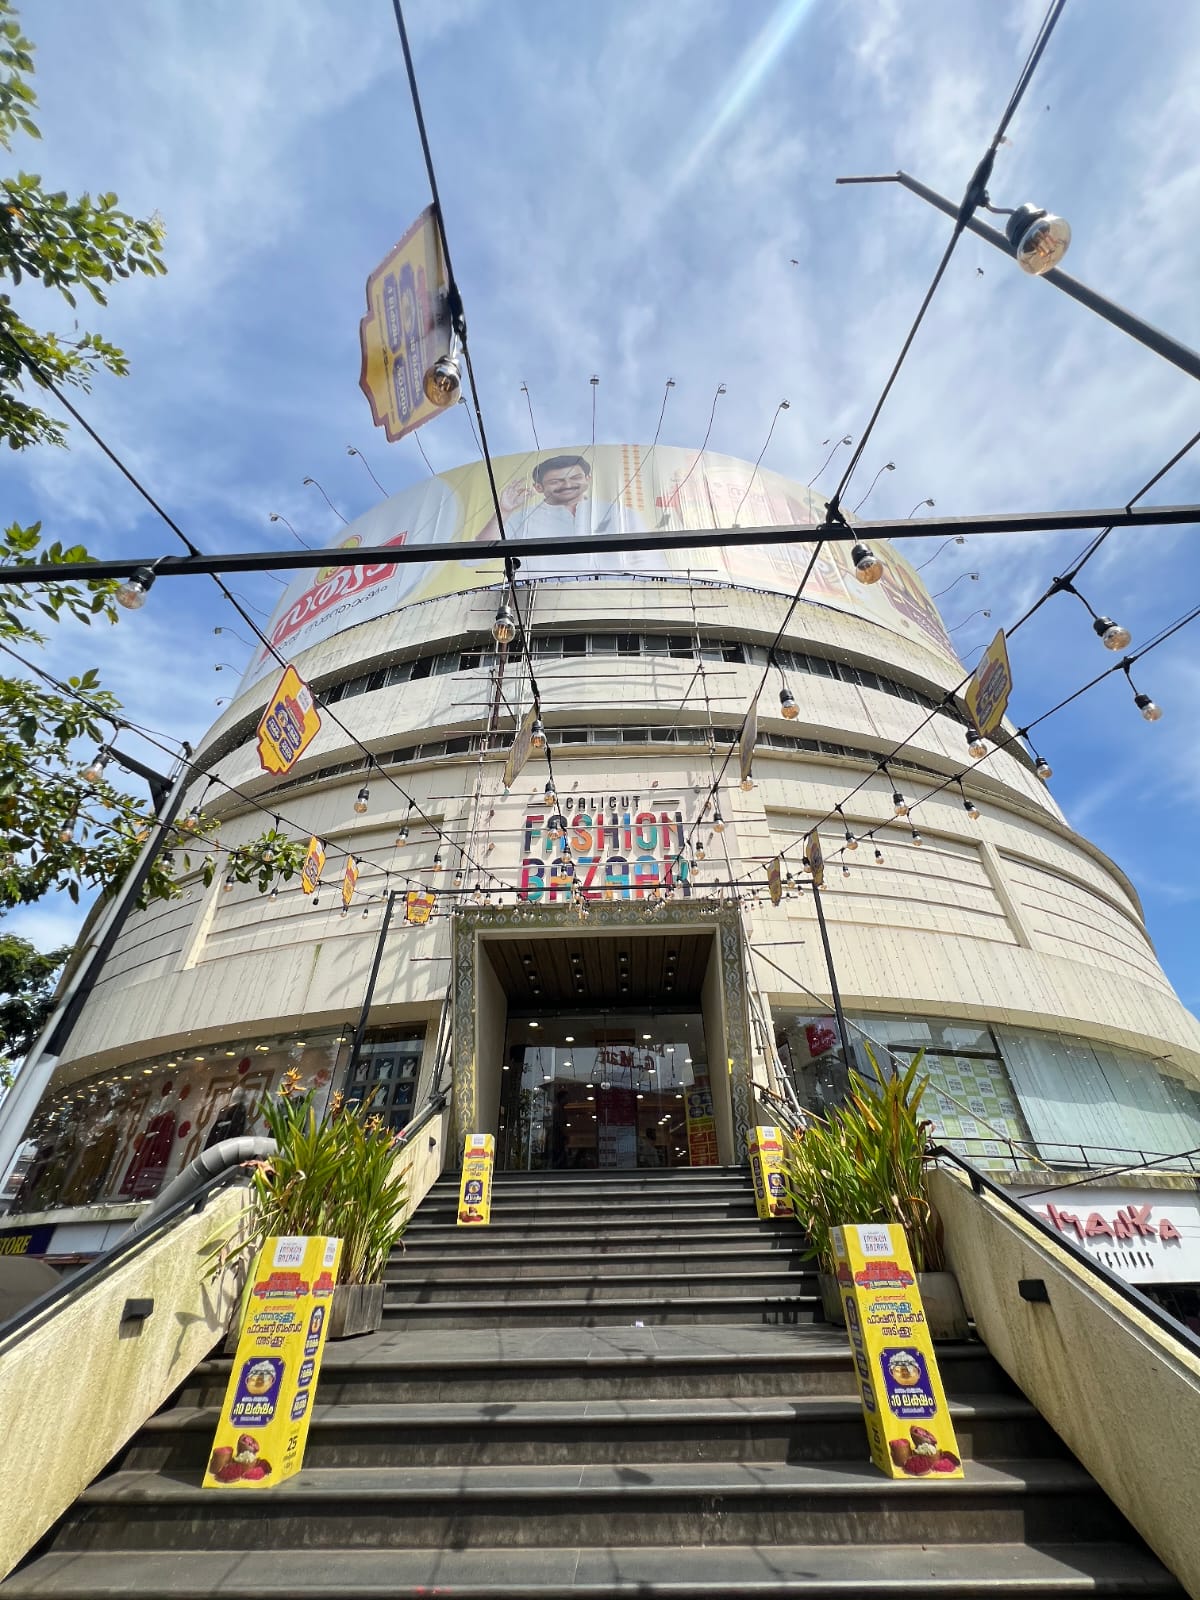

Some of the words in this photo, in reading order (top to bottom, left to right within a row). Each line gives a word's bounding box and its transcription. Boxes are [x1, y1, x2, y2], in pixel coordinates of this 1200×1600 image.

[566, 795, 641, 810] CALICUT
[524, 811, 685, 852] FASHION
[520, 855, 692, 902] BAZAAR
[286, 1435, 298, 1453] 25
